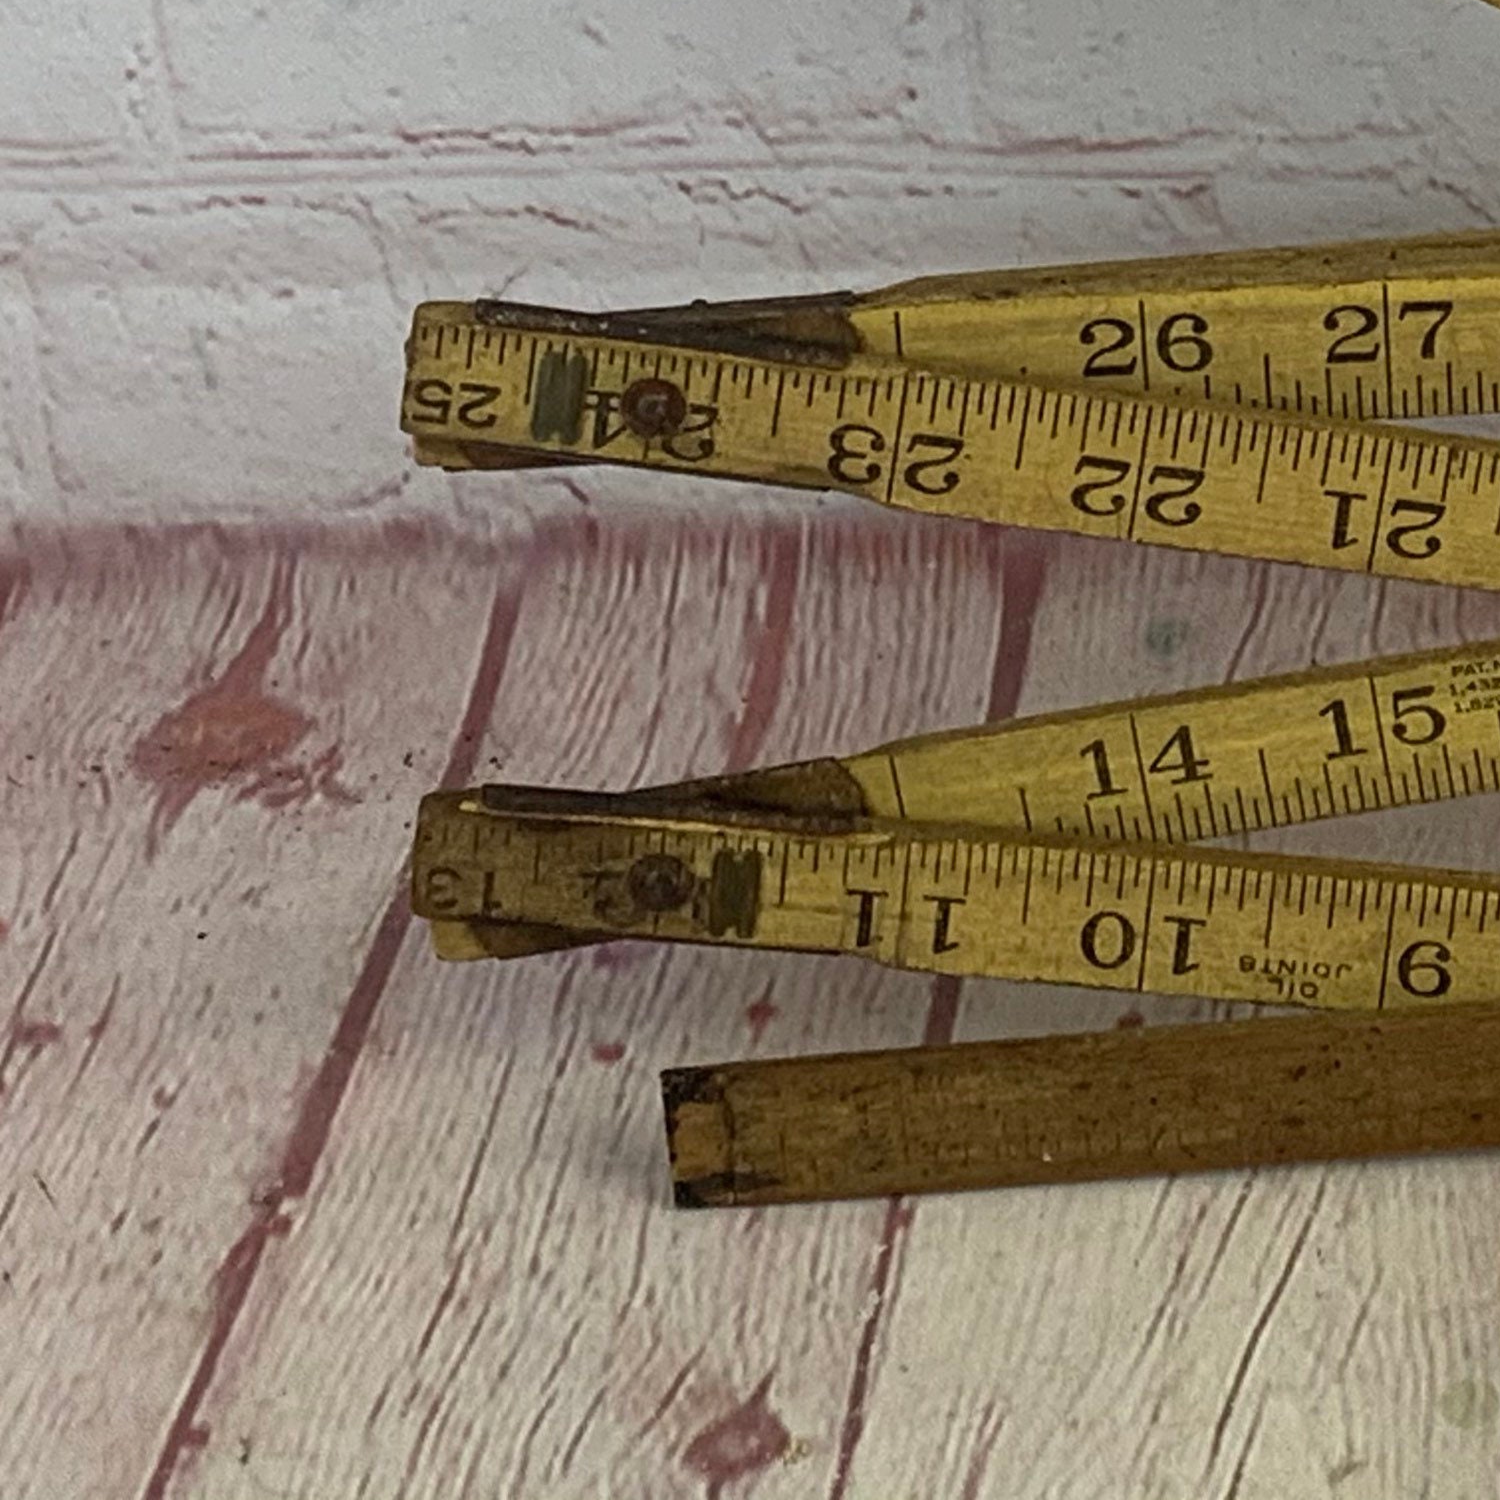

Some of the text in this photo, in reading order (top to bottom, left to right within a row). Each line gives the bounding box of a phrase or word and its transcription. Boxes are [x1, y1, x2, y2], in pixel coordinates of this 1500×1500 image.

[1078, 312, 1214, 377] 26
[1321, 301, 1453, 364] 27
[412, 378, 502, 430] 25
[826, 423, 965, 495] 23
[1069, 455, 1206, 527] 22
[1323, 489, 1447, 559] 21
[1080, 724, 1211, 801] 14
[1317, 684, 1447, 761] 15
[845, 888, 967, 955] 11
[1080, 911, 1208, 976] 10
[1239, 955, 1353, 979] JOINTS
[1267, 977, 1319, 999] OIL
[1398, 940, 1451, 997] 9
